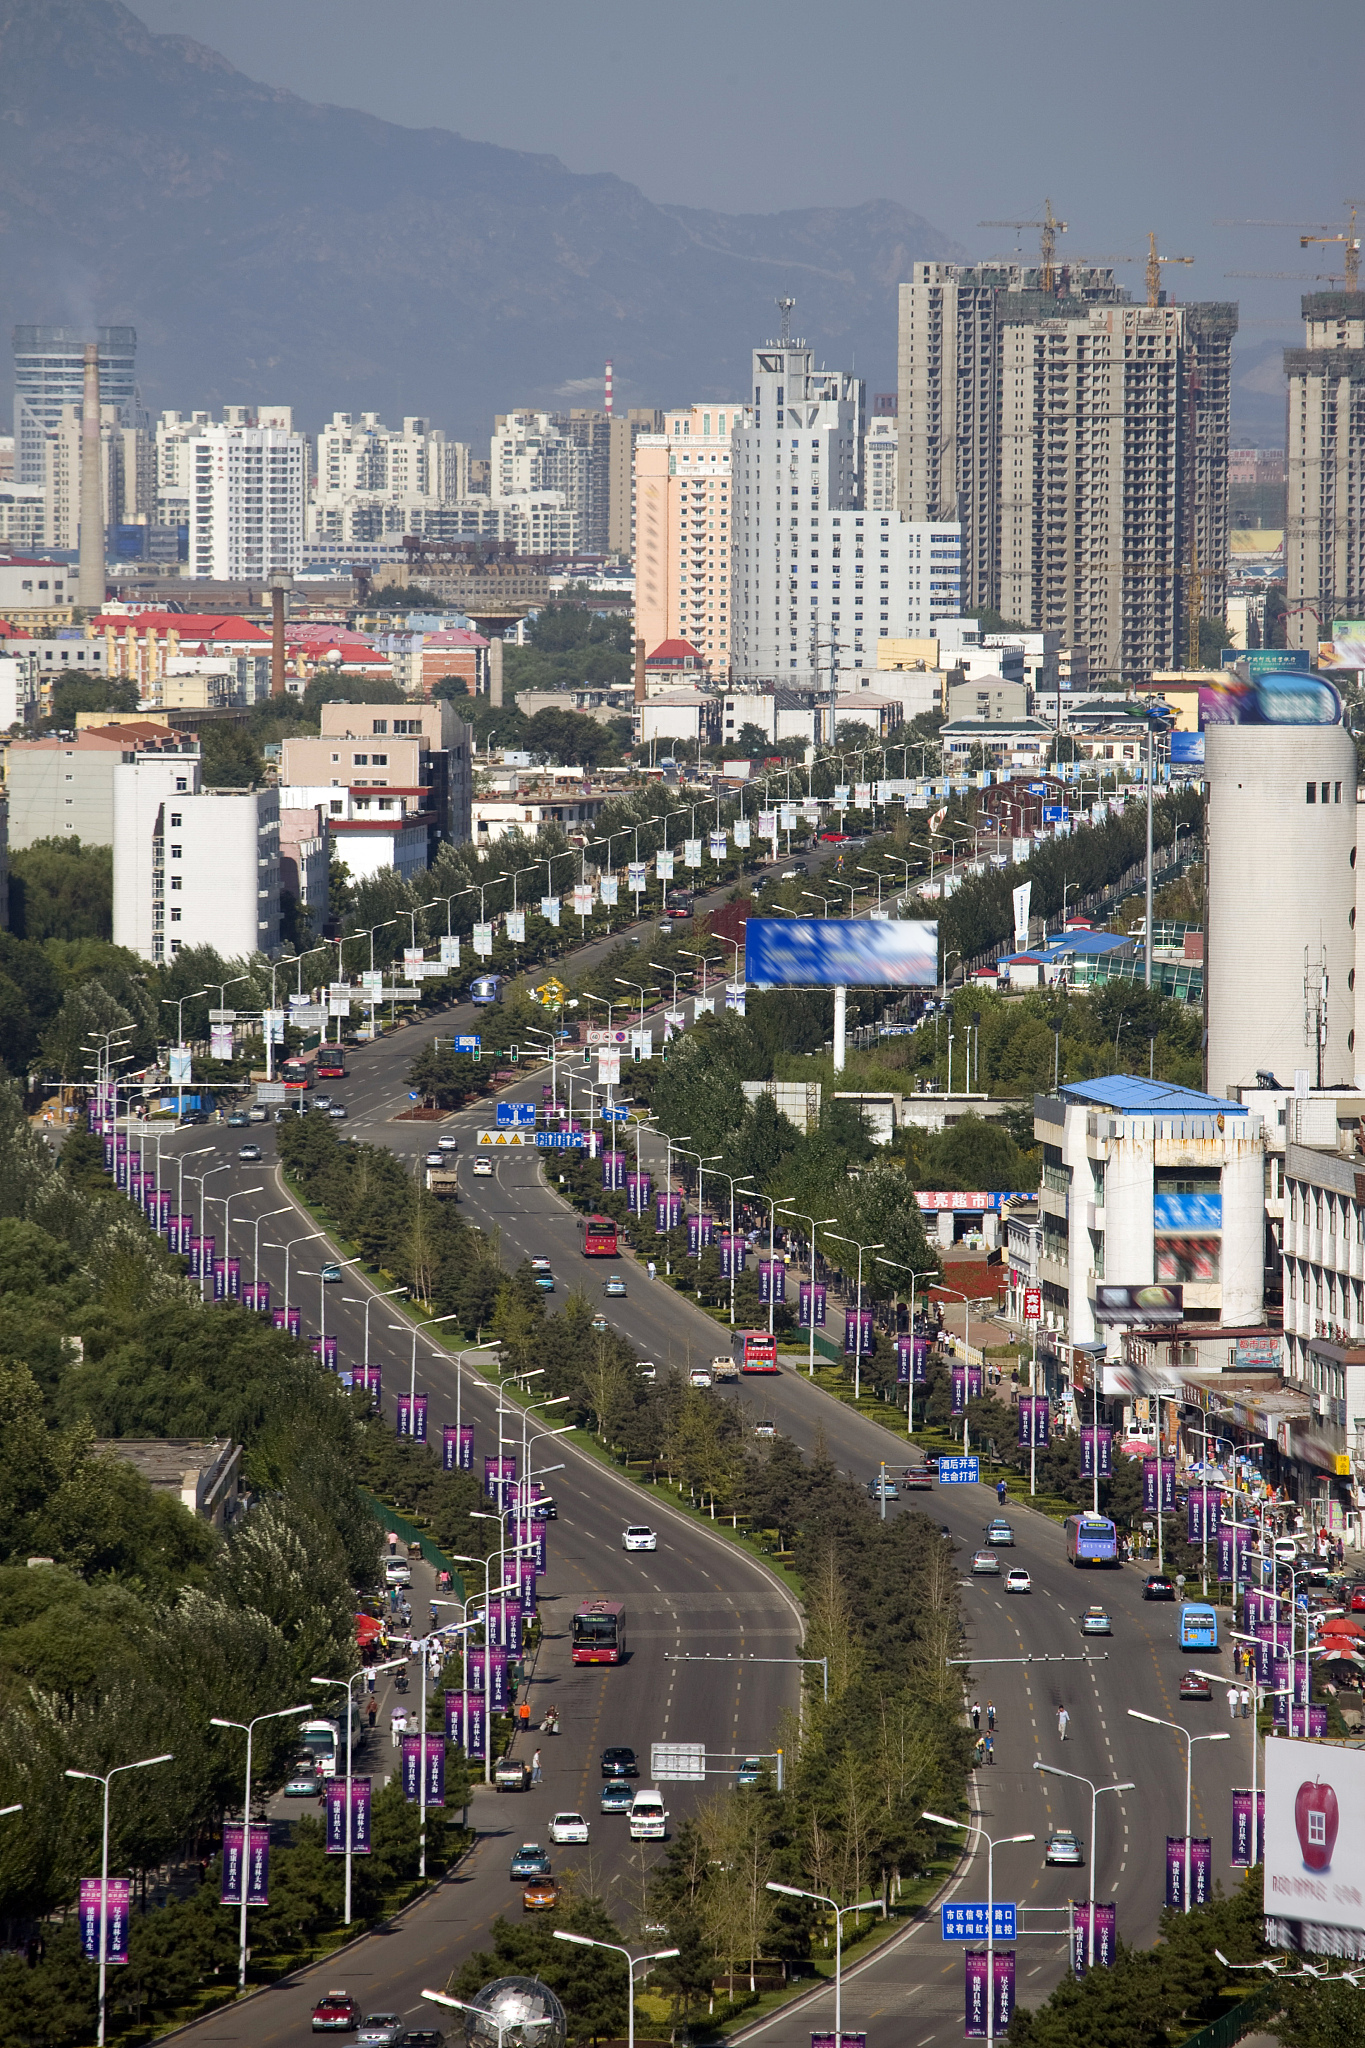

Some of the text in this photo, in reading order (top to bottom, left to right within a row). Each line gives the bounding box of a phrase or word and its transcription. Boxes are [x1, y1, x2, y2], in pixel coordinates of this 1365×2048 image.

[915, 1194, 986, 1208] 美亮超市
[1026, 1294, 1039, 1314] 宾馆
[1239, 1340, 1278, 1349] 都市庄园
[941, 1458, 977, 1470] 酒后开车
[941, 1471, 977, 1482] 生命打折
[1238, 1813, 1247, 1854] 健康自然人生
[230, 1848, 238, 1888] 健康自然人生
[254, 1848, 263, 1890] 尽享森林大海
[86, 1907, 95, 1950] 健康自然人生
[112, 1907, 122, 1950] 尽享森林大海
[972, 1976, 981, 2022] 健康自然人生
[1000, 1976, 1009, 2022] 尽享森林大海
